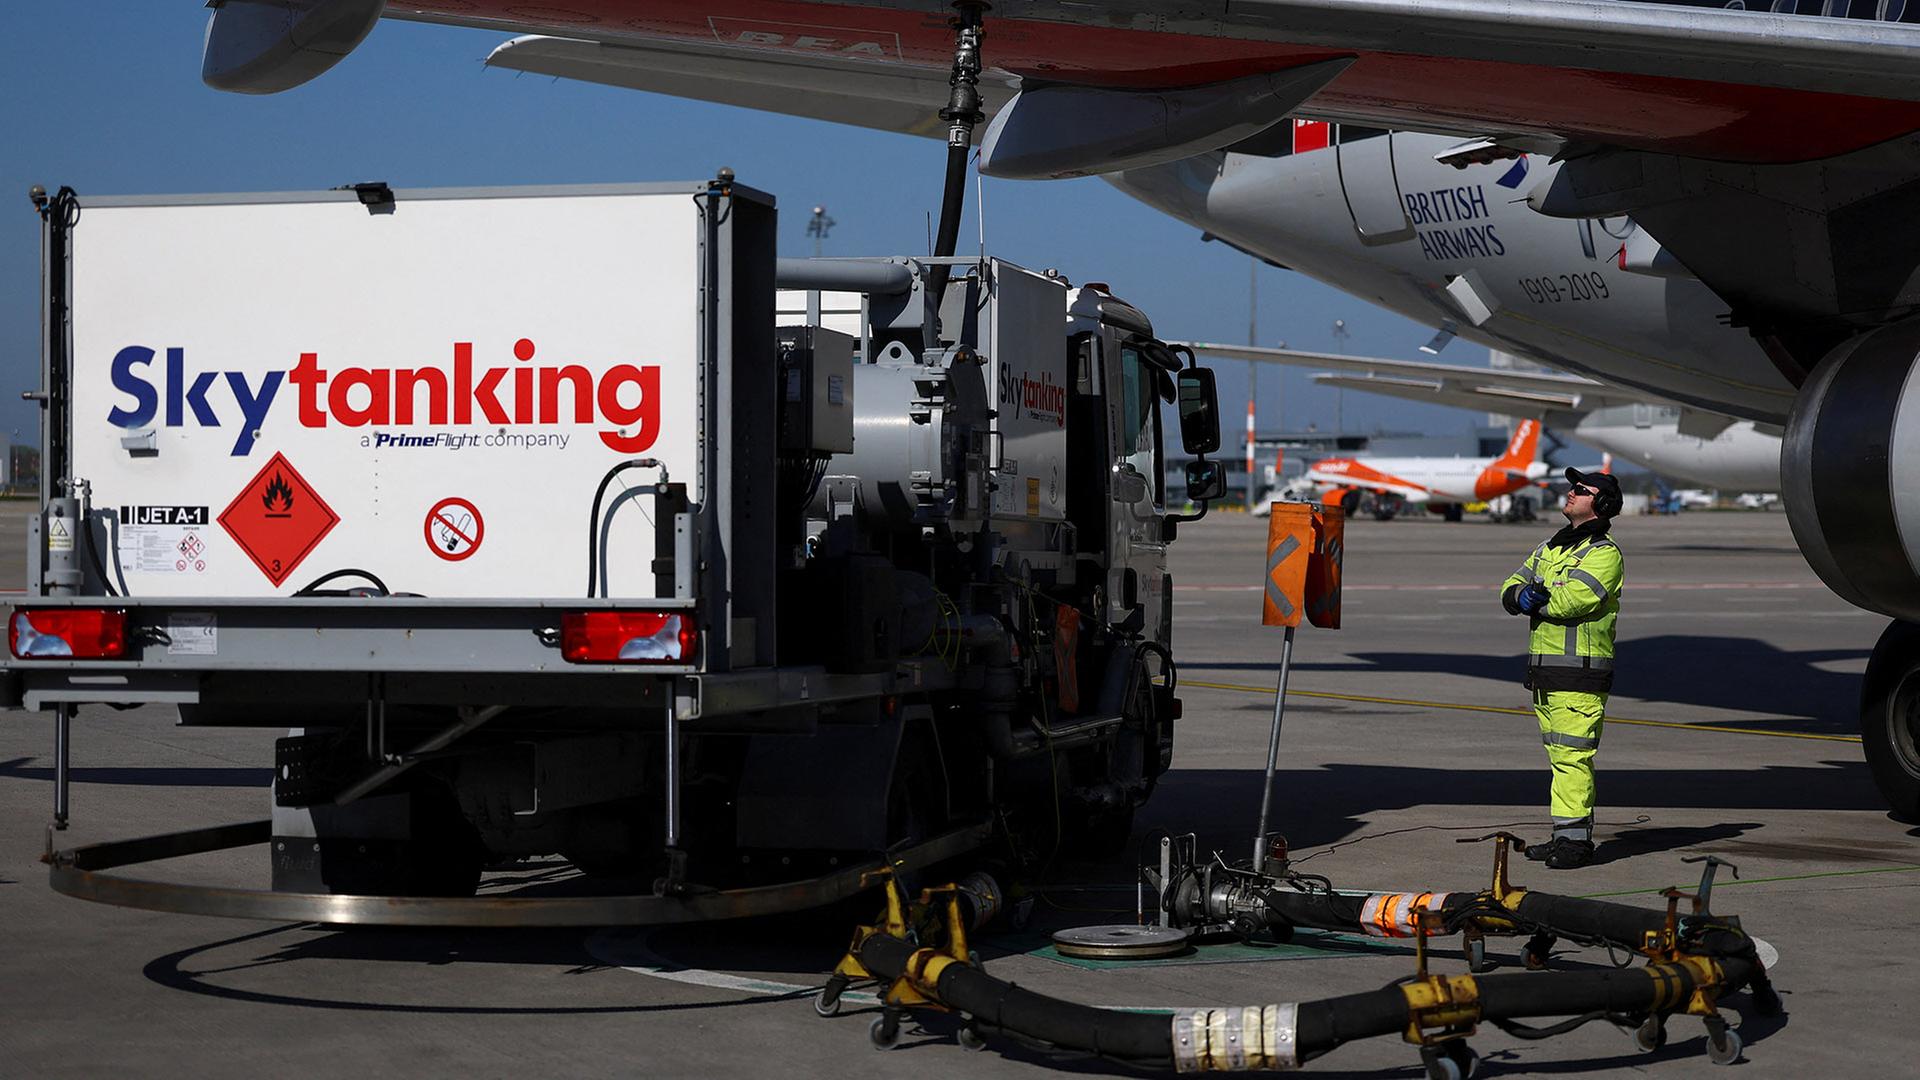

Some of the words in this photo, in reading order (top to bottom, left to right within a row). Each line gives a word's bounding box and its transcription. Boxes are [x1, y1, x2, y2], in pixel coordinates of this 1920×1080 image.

[1405, 184, 1490, 226] BRITISH
[1418, 224, 1506, 262] AIRWAYS
[1518, 271, 1610, 304] 1919-2019
[107, 338, 661, 456] Skytanking
[1000, 361, 1065, 428] Skytanking
[360, 435, 370, 448] a
[375, 433, 481, 451] PrimeFlight
[484, 433, 570, 450] company
[140, 507, 174, 524] JET
[175, 507, 202, 524] A-1
[271, 559, 282, 573] 3
